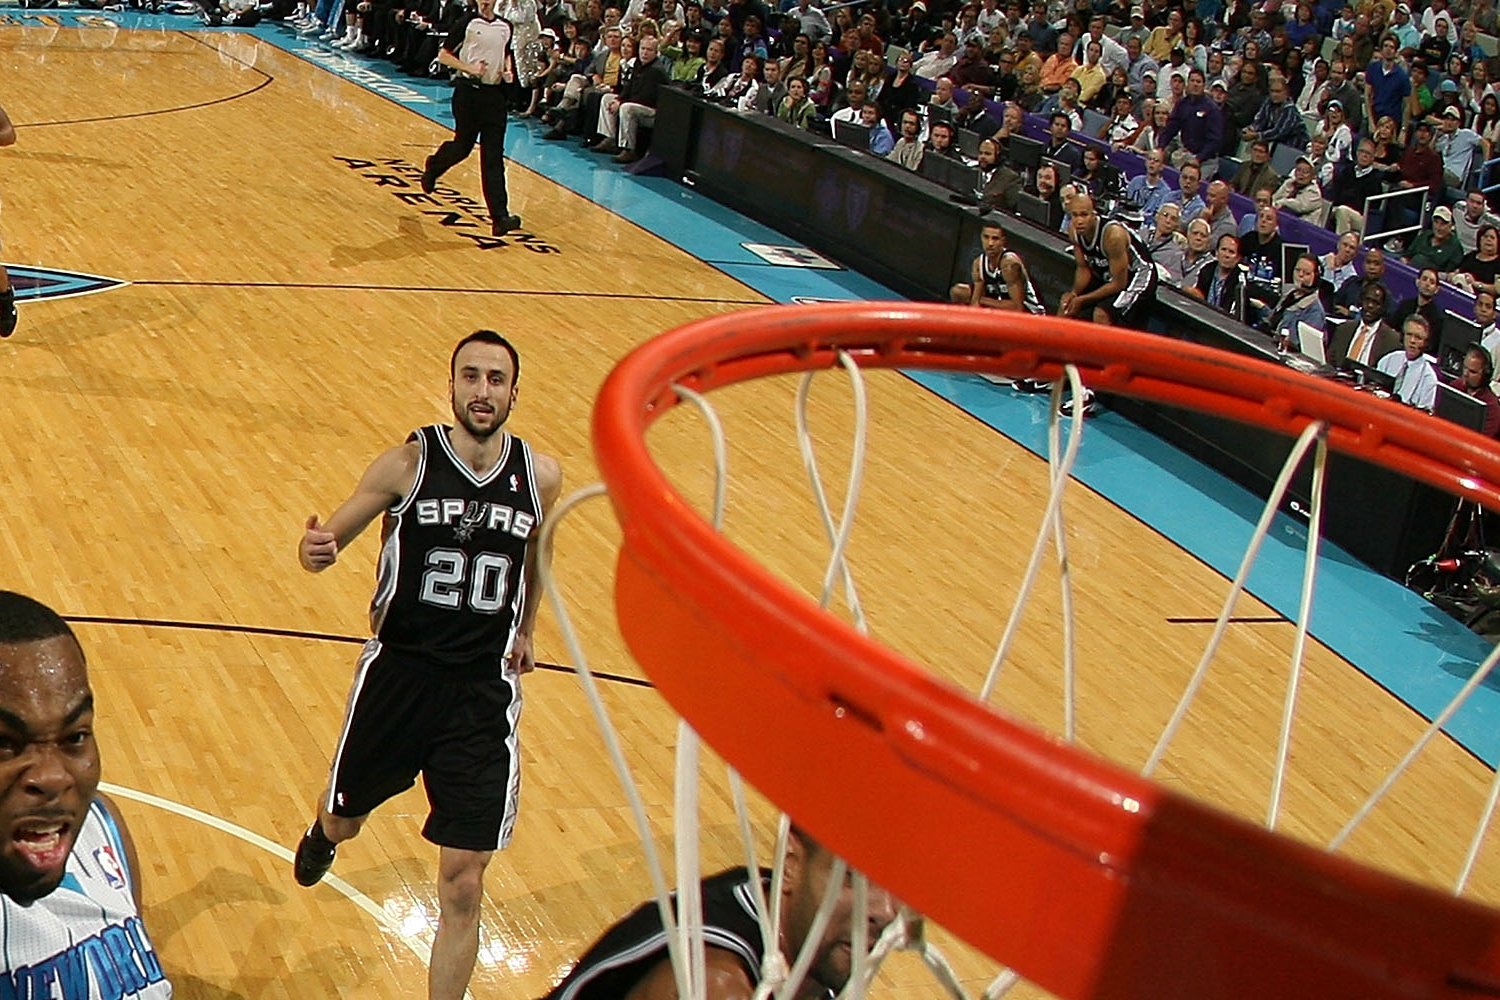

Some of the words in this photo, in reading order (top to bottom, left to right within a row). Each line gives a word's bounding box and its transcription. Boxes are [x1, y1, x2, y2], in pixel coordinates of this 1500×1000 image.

[333, 156, 510, 250] ARENA
[416, 499, 535, 542] SPURS
[418, 546, 513, 614] 20
